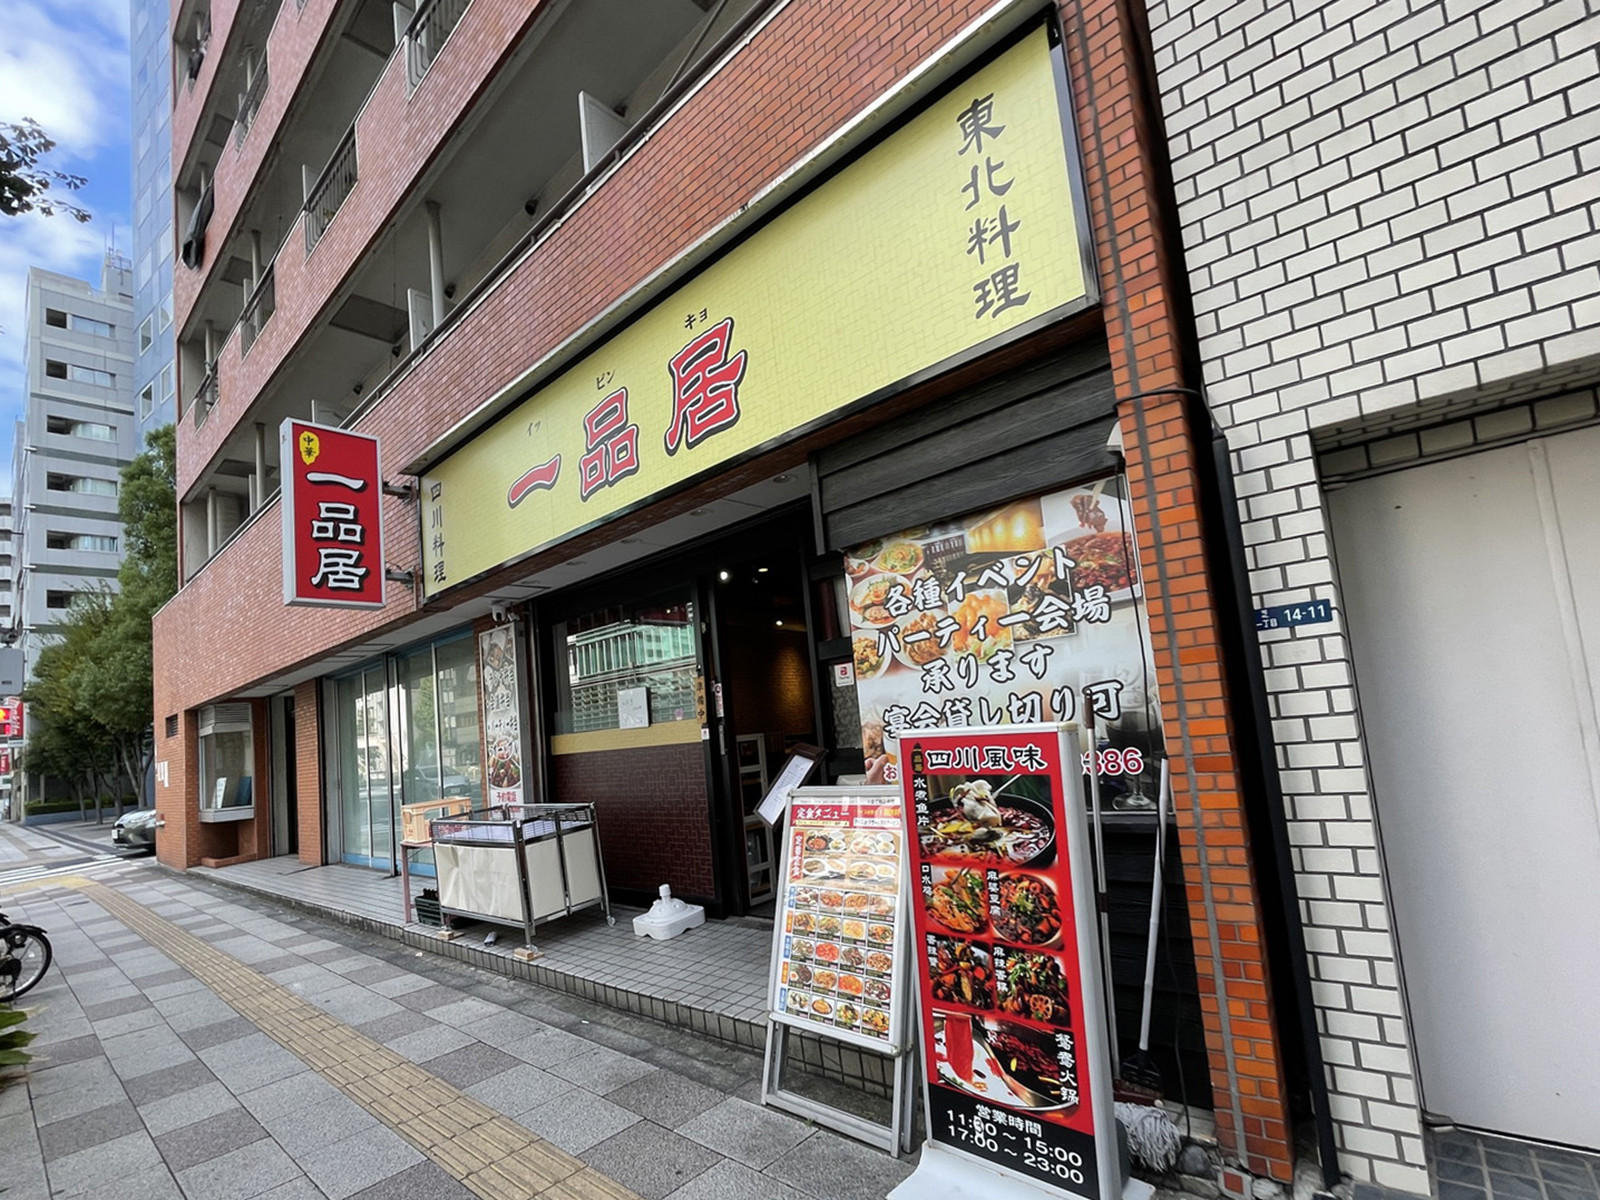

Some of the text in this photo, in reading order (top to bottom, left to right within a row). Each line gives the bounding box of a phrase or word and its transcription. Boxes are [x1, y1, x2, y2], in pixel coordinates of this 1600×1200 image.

[956, 93, 1031, 319] 東北料理
[508, 317, 748, 509] 一品居
[306, 471, 369, 590] 一品居
[430, 482, 447, 584] 四川料理
[883, 545, 1075, 617] 各種イベント
[877, 586, 1111, 657] パーティー会場
[1284, 605, 1325, 622] 14-11
[921, 644, 1054, 694] 承ります
[882, 680, 1124, 739] 宴会貸し切り可
[925, 744, 1048, 773] 四川風味
[975, 1103, 1043, 1138] 営業時間
[948, 1124, 999, 1152] 17:00
[1023, 1151, 1084, 1185] 23:00
[1024, 1136, 1083, 1167] 15:00
